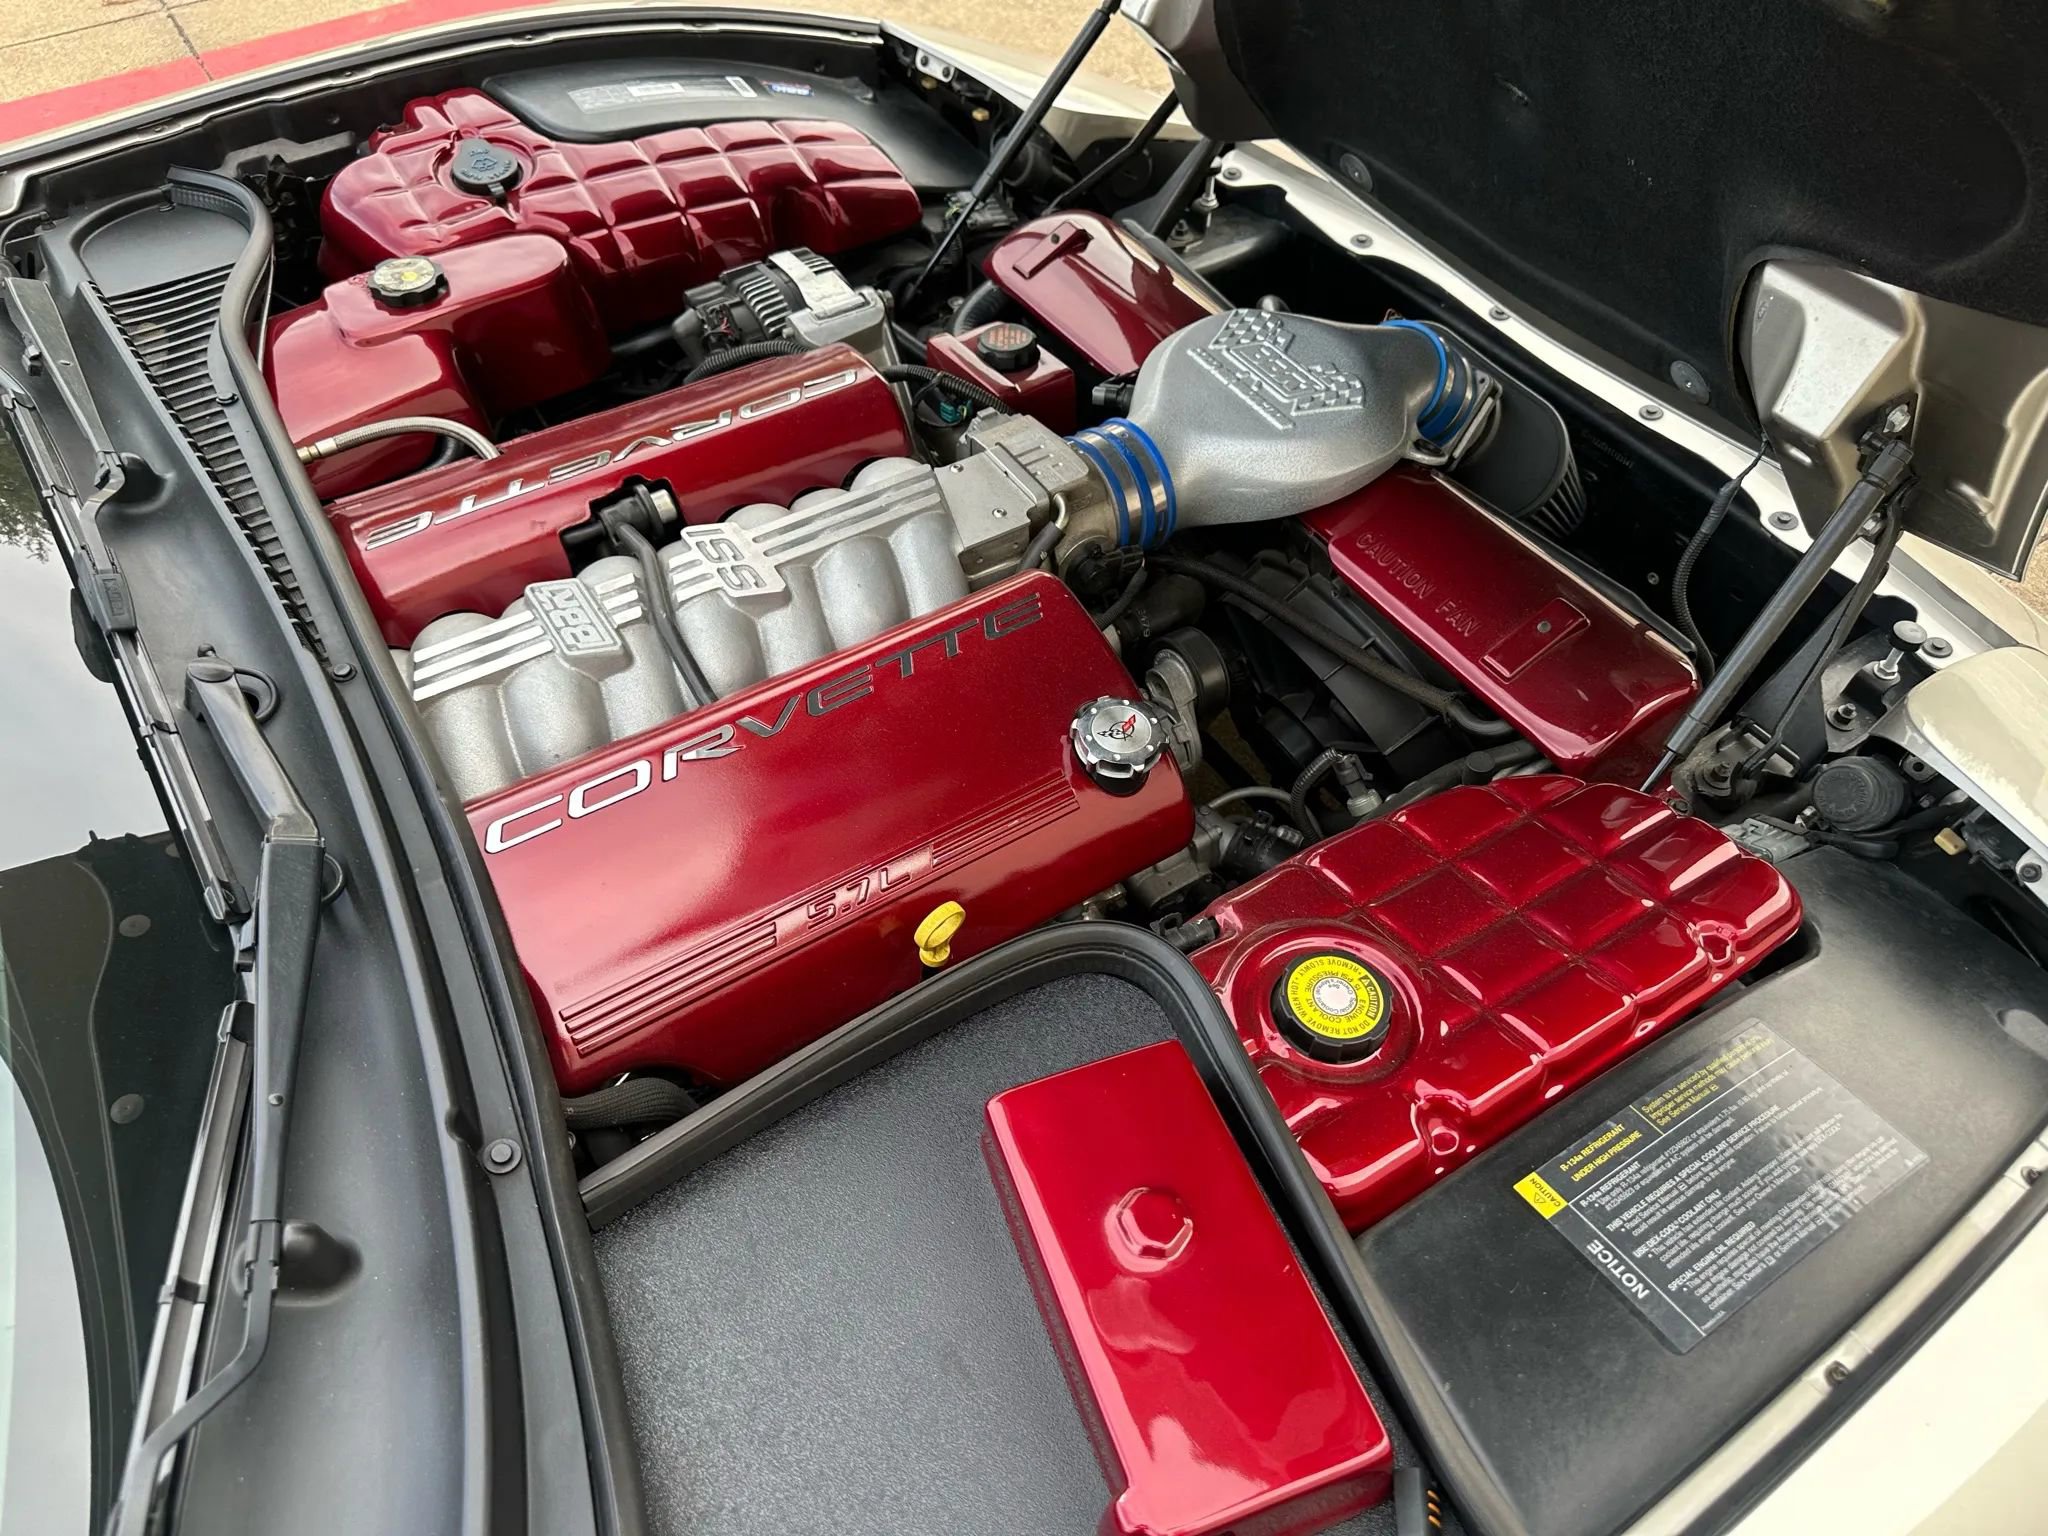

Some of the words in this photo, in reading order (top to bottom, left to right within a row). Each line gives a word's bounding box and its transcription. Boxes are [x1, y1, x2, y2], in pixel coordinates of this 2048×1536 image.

[367, 369, 858, 550] CORVETTE
[687, 528, 766, 591] SSI
[1356, 532, 1437, 599] CAUTION
[1435, 597, 1480, 637] FAN
[535, 584, 599, 647] BBK
[485, 593, 1043, 854] CORVETTE
[807, 867, 911, 929] 5.7L
[1290, 980, 1299, 996] HOT
[1299, 958, 1325, 976] SLOWLY
[1305, 971, 1340, 992] PRESSURE
[1315, 980, 1330, 997] Manual
[1327, 958, 1359, 972] REMOVE
[1330, 978, 1354, 994] Owner's
[1340, 972, 1354, 982] PSI
[1292, 996, 1308, 1019] WHEN
[1306, 998, 1342, 1023] COOLANT
[1316, 996, 1340, 1014] Coolant
[1339, 996, 1357, 1014] Special
[1346, 999, 1366, 1023] ENGINE
[1360, 1019, 1370, 1030] DO
[1366, 985, 1379, 1018] CAUTION
[1307, 1018, 1342, 1035] REMOVE
[1343, 1025, 1360, 1035] NOT
[1641, 1095, 1667, 1114] System
[1662, 1091, 1673, 1100] to
[1668, 1086, 1681, 1096] be
[1675, 1071, 1702, 1091] serviced
[1697, 1067, 1709, 1076] by
[1649, 1099, 1677, 1119] Improper
[1673, 1088, 1695, 1103] service
[1692, 1073, 1716, 1091] methods
[1713, 1066, 1728, 1077] may
[1656, 1114, 1672, 1126] See
[1667, 1100, 1692, 1118] Service
[1688, 1087, 1711, 1104] Manual
[1558, 1152, 1584, 1171] R-134a
[1579, 1123, 1626, 1156] REFRIGERANT
[1570, 1162, 1596, 1181] UNDER
[1591, 1151, 1612, 1166] HIGH
[1606, 1130, 1643, 1156] PRESSURE
[1596, 1193, 1612, 1205] Use
[1607, 1185, 1623, 1197] only
[1619, 1172, 1642, 1189] R-134a
[1638, 1154, 1667, 1176] refrigerant
[1695, 1116, 1722, 1136] equivalent
[1606, 1217, 1624, 1231] THIS
[1620, 1199, 1648, 1221] VEHICLE
[1645, 1179, 1677, 1203] REQUIRES
[1673, 1175, 1682, 1183] A
[1678, 1158, 1705, 1179] SPECIAL
[1701, 1141, 1730, 1162] COOLANT
[1726, 1125, 1751, 1144] SERVICE
[1747, 1104, 1780, 1128] PROCEDURE
[1638, 1164, 1667, 1186] equivalent
[1678, 1141, 1699, 1157] system
[1695, 1136, 1707, 1145] will
[1703, 1131, 1714, 1139] be
[1528, 1176, 1562, 1208] CAUTION
[1579, 1189, 1602, 1207] R-134a
[1598, 1161, 1642, 1192] REFRIGERANT
[1623, 1215, 1641, 1229] Read
[1638, 1201, 1660, 1219] Service
[1657, 1187, 1680, 1205] Manual
[1685, 1170, 1704, 1185] before
[1712, 1154, 1726, 1165] and
[1630, 1222, 1648, 1236] could
[1645, 1211, 1663, 1225] result
[1665, 1194, 1687, 1211] serious
[1683, 1179, 1707, 1197] damage
[1708, 1168, 1721, 1179] the
[1633, 1244, 1649, 1257] USE
[1677, 1200, 1708, 1223] COOLANT
[1704, 1188, 1722, 1203] ONLY
[1651, 1243, 1665, 1255] This
[1662, 1229, 1684, 1246] vehicle
[1680, 1222, 1694, 1233] has
[1690, 1205, 1716, 1225] extended
[1713, 1199, 1725, 1208] life
[1658, 1244, 1680, 1262] coolant
[1687, 1220, 1713, 1240] requiring
[1709, 1206, 1730, 1223] change
[1726, 1196, 1744, 1210] much
[1664, 1247, 1692, 1269] extended
[1688, 1241, 1700, 1251] life
[1696, 1228, 1717, 1244] engine
[1733, 1205, 1747, 1216] See
[1743, 1196, 1758, 1208] your
[1754, 1182, 1776, 1199] Owner's
[1773, 1169, 1792, 1185] Manual
[1754, 1245, 1771, 1259] have
[1767, 1238, 1779, 1249] the
[1775, 1221, 1801, 1242] American
[1585, 1238, 1651, 1300] NOTICE
[1666, 1267, 1696, 1291] SPECIAL
[1691, 1250, 1718, 1271] ENGINE
[1713, 1242, 1727, 1254] OIL
[1723, 1220, 1756, 1246] REQUIRED
[1685, 1275, 1701, 1289] This
[1697, 1262, 1719, 1280] engine
[1714, 1246, 1739, 1266] requires
[1734, 1232, 1756, 1250] special
[1777, 1205, 1791, 1217] GM
[1692, 1280, 1713, 1297] cause
[1708, 1266, 1730, 1284] engine
[1726, 1250, 1751, 1270] damage
[1747, 1243, 1759, 1254] not
[1754, 1228, 1779, 1248] covered
[1732, 1278, 1746, 1290] See
[1778, 1235, 1800, 1253] Service
